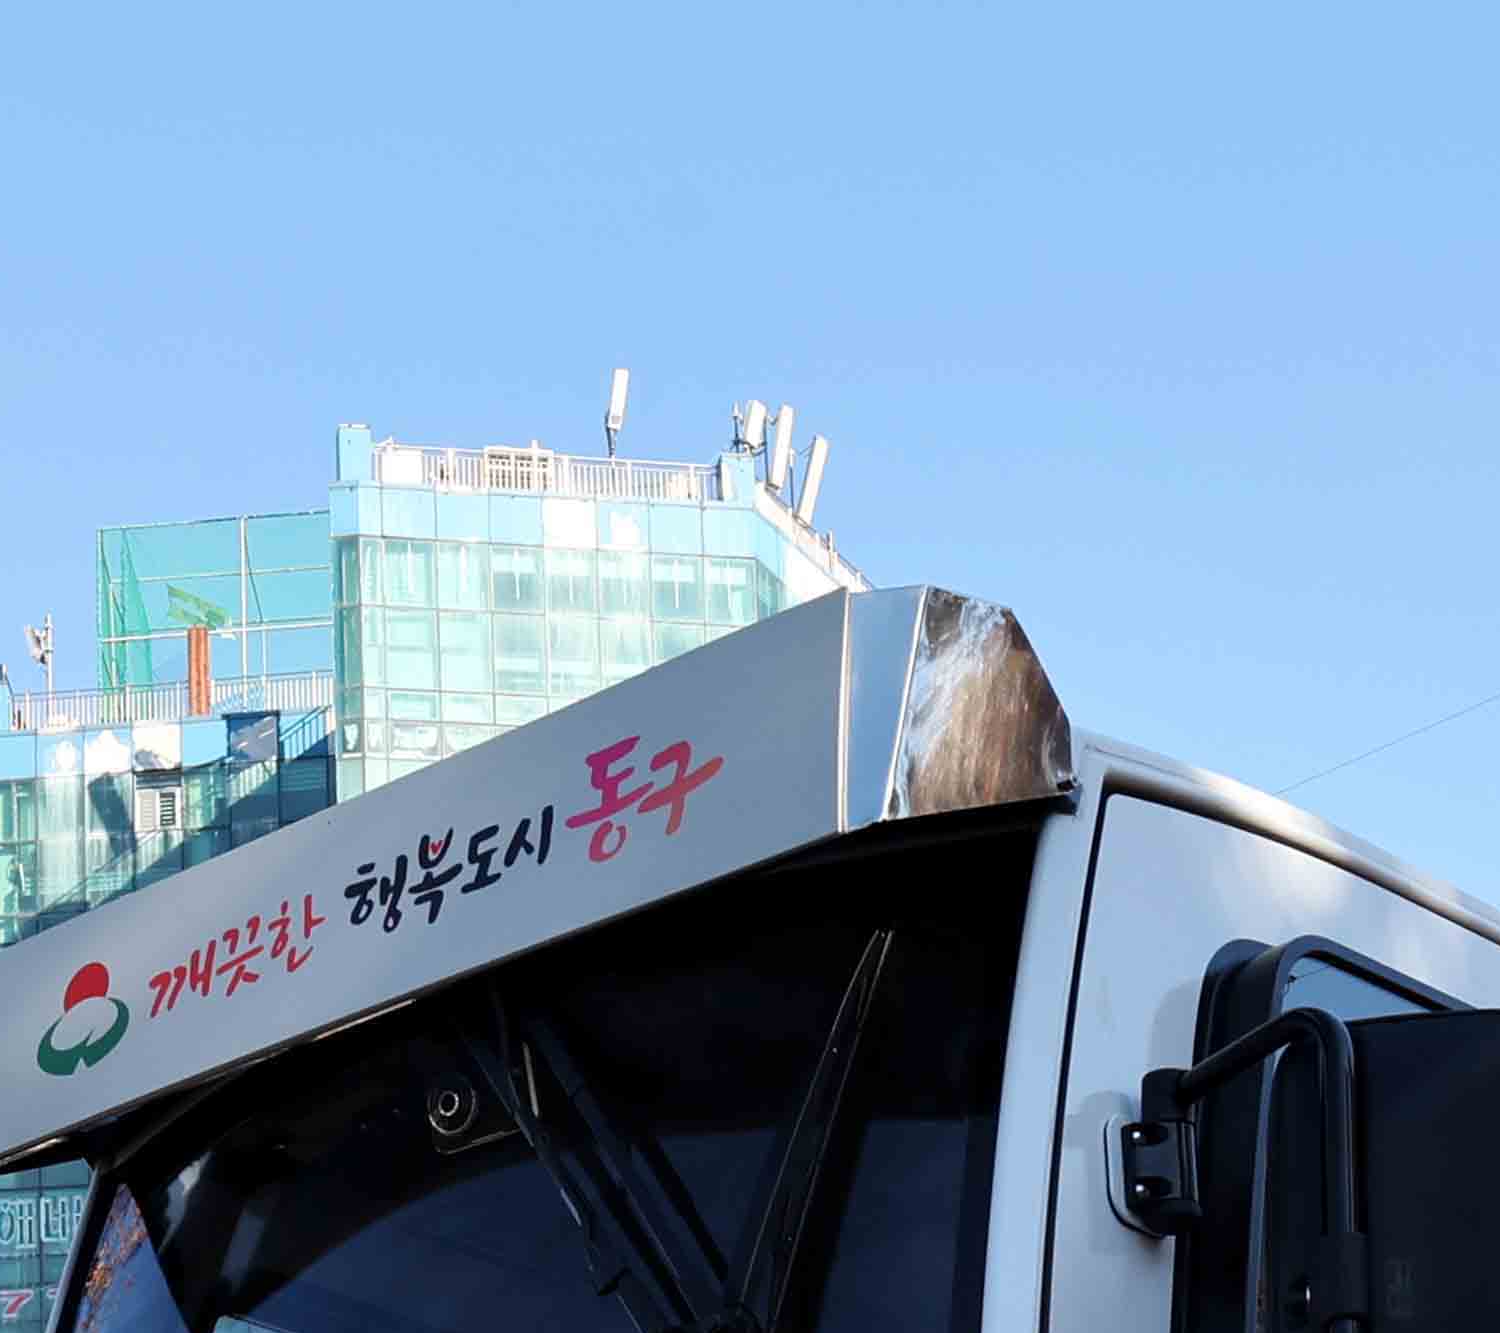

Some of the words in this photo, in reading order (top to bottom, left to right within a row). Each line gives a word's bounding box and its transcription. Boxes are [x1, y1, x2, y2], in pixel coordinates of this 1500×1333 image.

[147, 894, 324, 1020] 깨끗한
[344, 806, 554, 934] 행복도시
[566, 735, 724, 862] 동구
